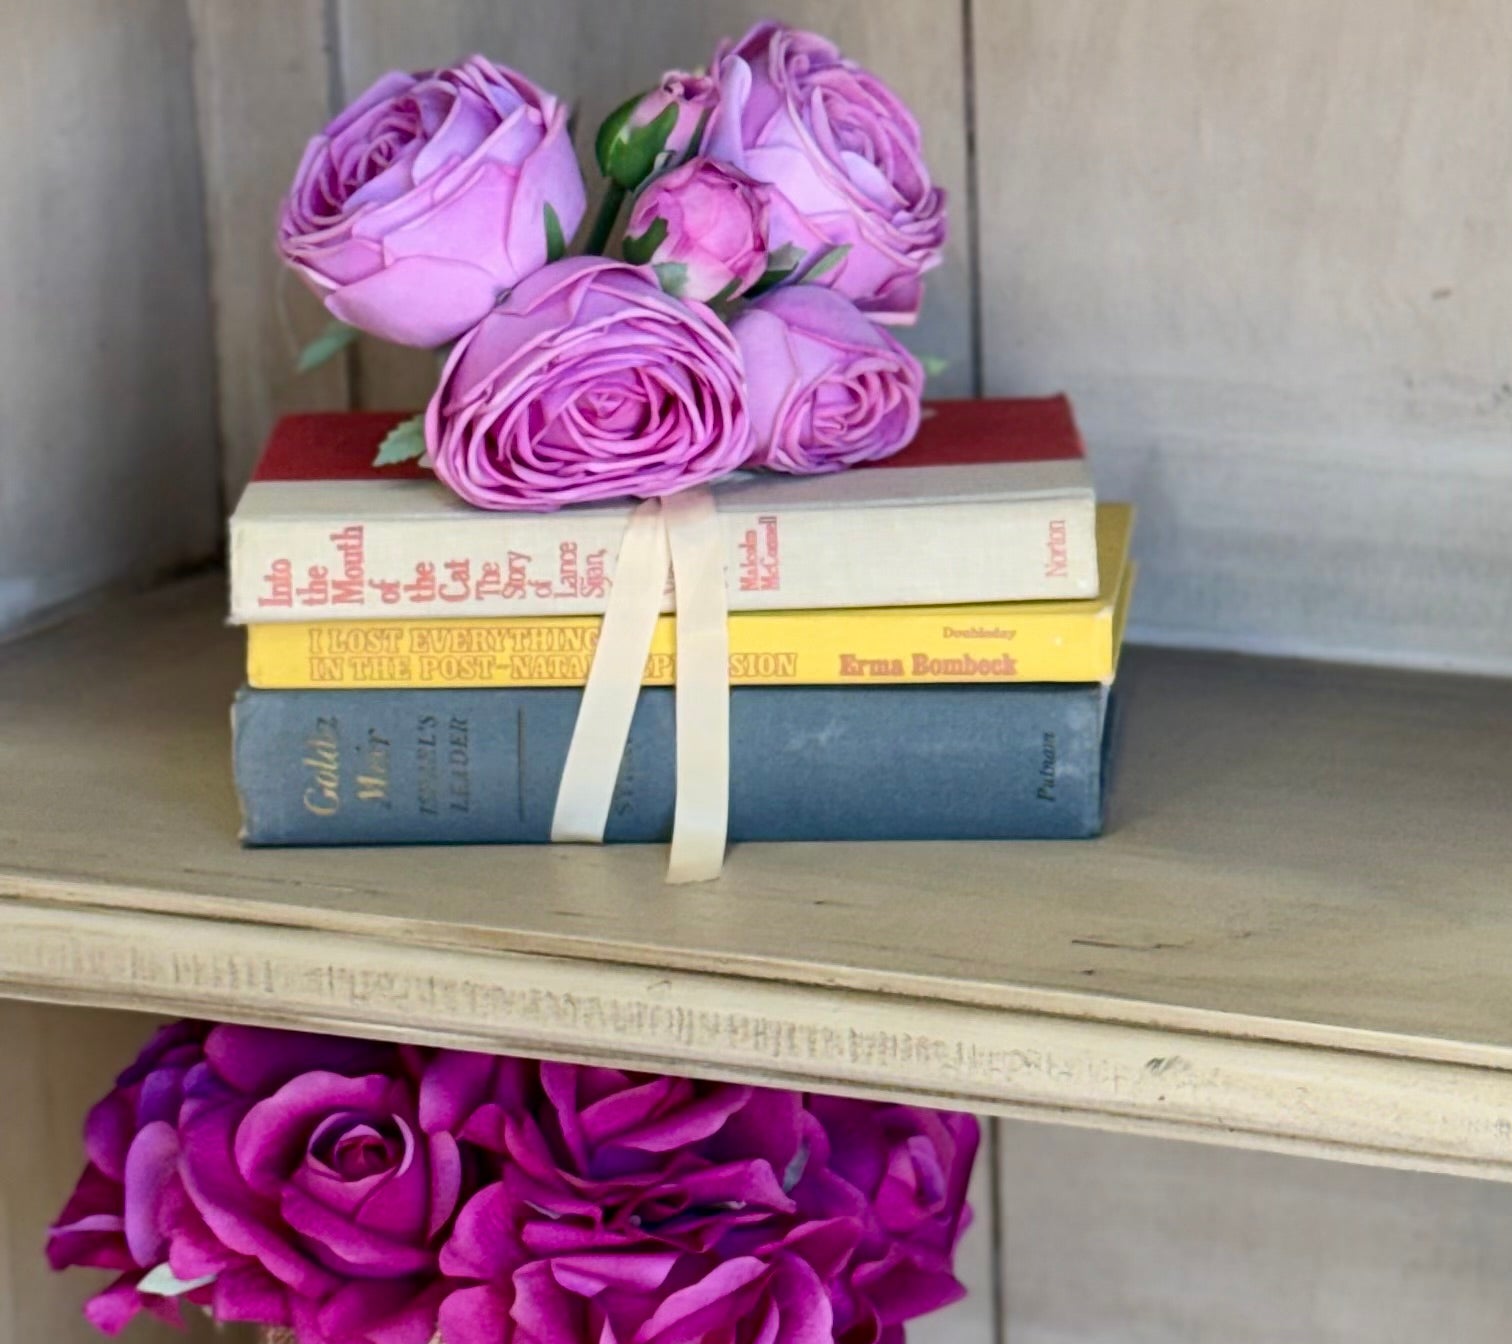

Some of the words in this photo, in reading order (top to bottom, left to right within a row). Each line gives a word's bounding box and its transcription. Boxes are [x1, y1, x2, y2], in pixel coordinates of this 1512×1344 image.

[330, 525, 364, 605] Mouth
[1045, 520, 1067, 578] Norton
[258, 559, 292, 607] Into
[296, 566, 328, 606] the
[403, 561, 436, 602] the
[438, 558, 470, 602] Cat
[475, 562, 501, 600] The
[502, 550, 532, 599] Story
[528, 579, 552, 598] of
[554, 542, 578, 598] Lance
[368, 578, 401, 604] of
[309, 628, 321, 654] I
[328, 628, 403, 654] LOST
[309, 656, 344, 681] IN
[351, 656, 412, 681] THE
[420, 654, 592, 680] POST-NATA
[839, 654, 905, 677] Erma
[911, 653, 1017, 676] Bombeck
